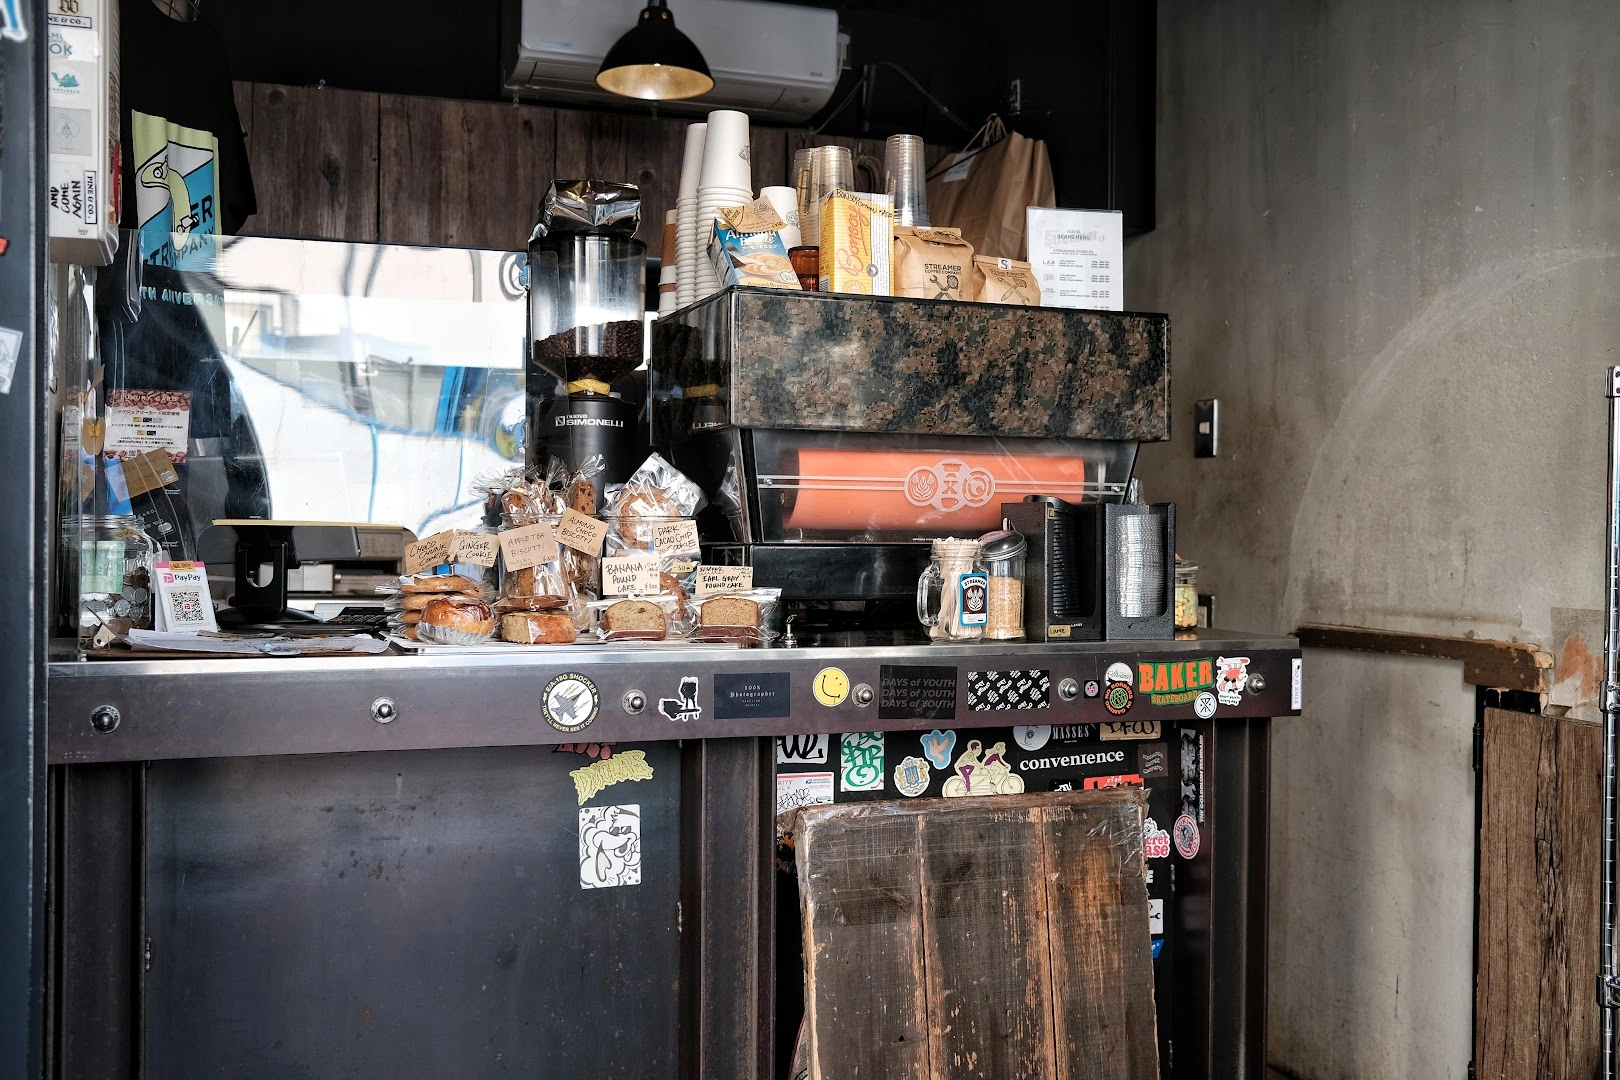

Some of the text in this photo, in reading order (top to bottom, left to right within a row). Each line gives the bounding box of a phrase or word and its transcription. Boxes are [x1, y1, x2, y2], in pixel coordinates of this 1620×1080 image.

[50, 187, 59, 208] AND
[61, 183, 70, 213] COME
[71, 180, 81, 219] AGAIN
[924, 263, 962, 272] STREAMER
[566, 419, 624, 428] SIMONELLI
[567, 516, 596, 530] ALMOND
[561, 527, 593, 544] BISCOTTI
[575, 527, 598, 538] CHOCO
[657, 525, 679, 536] DARK
[654, 531, 693, 547] CACAO CHIP
[667, 539, 696, 550] COOKIE
[409, 541, 437, 557] CHOCO
[459, 540, 490, 550] GINGER
[511, 543, 545, 557] BISCOTTI
[465, 550, 493, 559] COOKIE
[605, 562, 644, 575] BANANA
[174, 574, 201, 582] PayPay
[612, 574, 637, 584] POUND
[963, 578, 986, 587] STREAMER
[617, 584, 637, 593] CAKE
[1050, 628, 1067, 636] Large
[1138, 661, 1213, 692] BAKER
[569, 673, 597, 694] SHOCKER
[881, 678, 956, 687] DAYS of YOUTH
[881, 688, 955, 697] DAYS of YOUTH
[881, 699, 955, 708] DAYS of YOUTH
